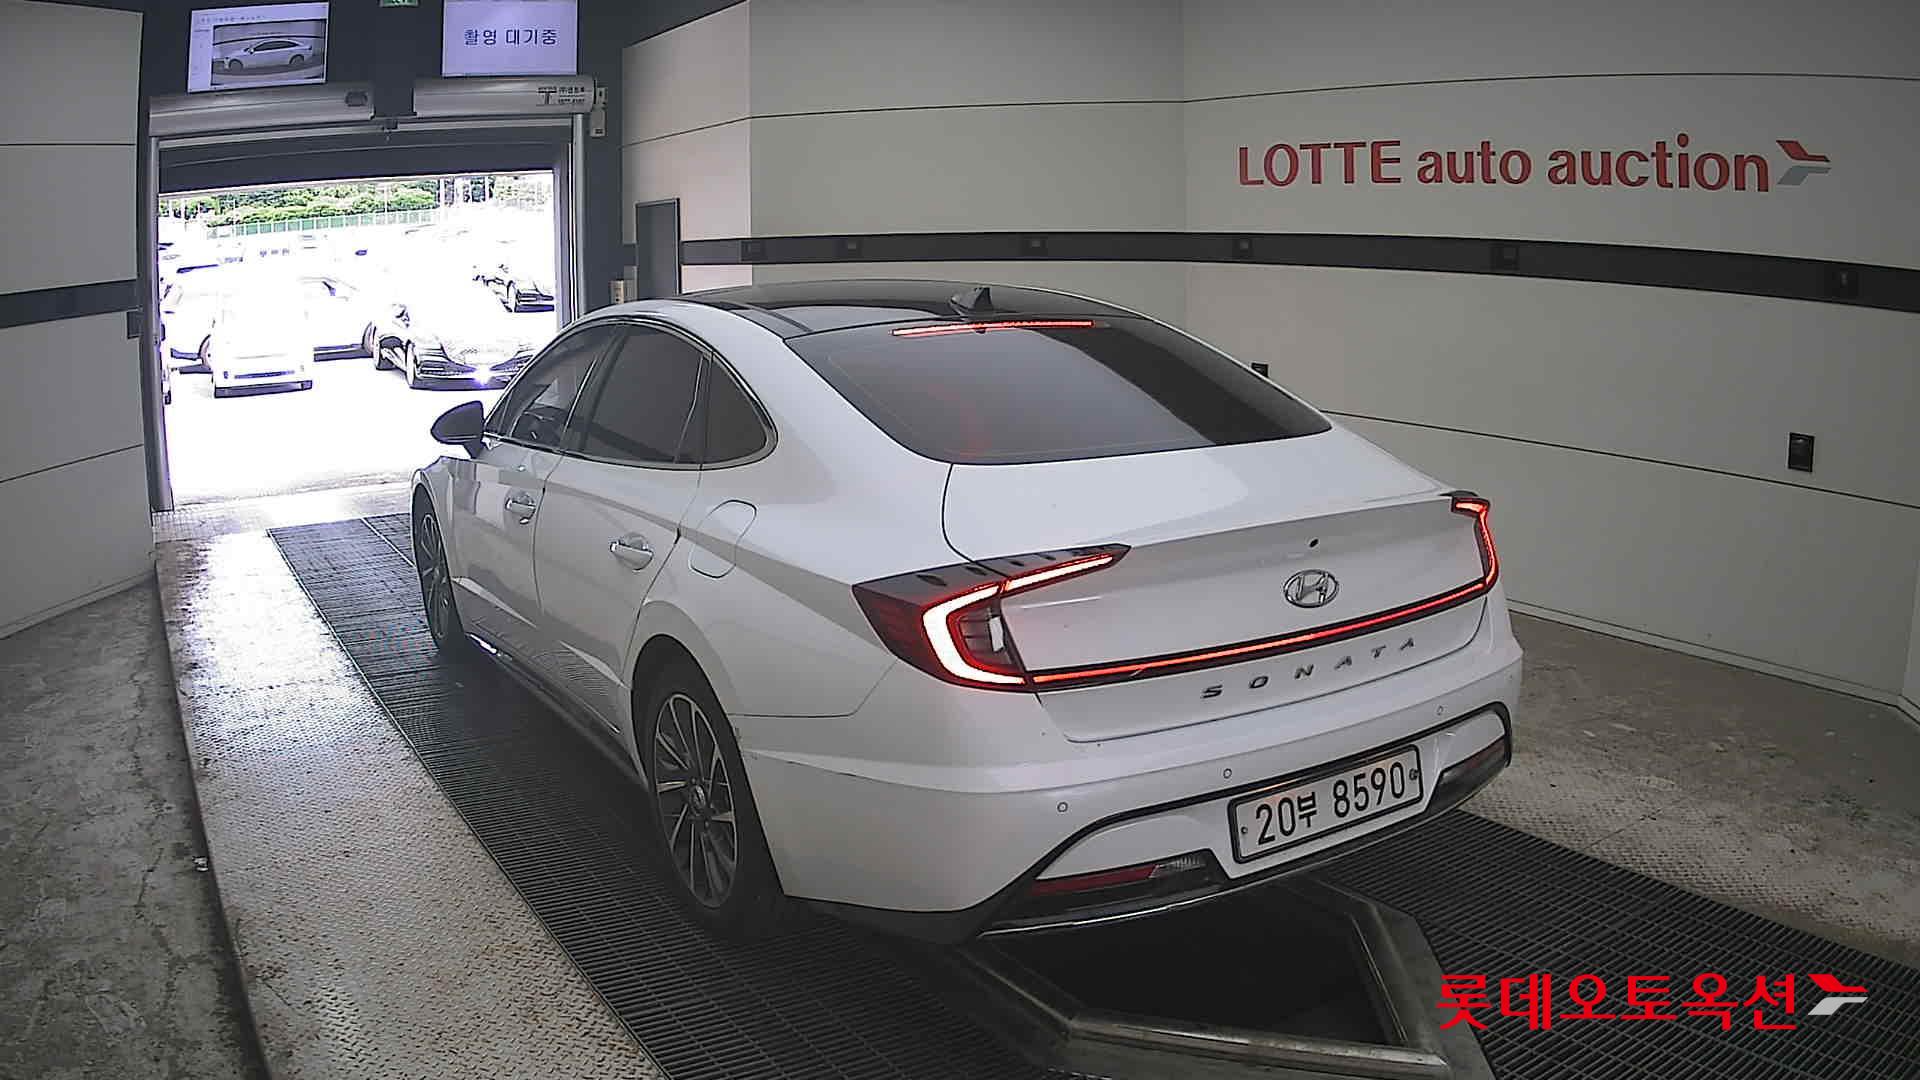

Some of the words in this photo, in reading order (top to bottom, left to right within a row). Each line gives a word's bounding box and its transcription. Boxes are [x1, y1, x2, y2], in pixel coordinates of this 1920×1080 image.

[464, 29, 497, 46] 촬영
[505, 29, 558, 46] 대기중
[1238, 139, 1400, 186] LOTTE
[1416, 140, 1533, 186] auto
[1547, 133, 1770, 192] auction
[1201, 638, 1415, 699] SONATA
[1255, 791, 1318, 845] 20부
[1333, 761, 1406, 818] 8590
